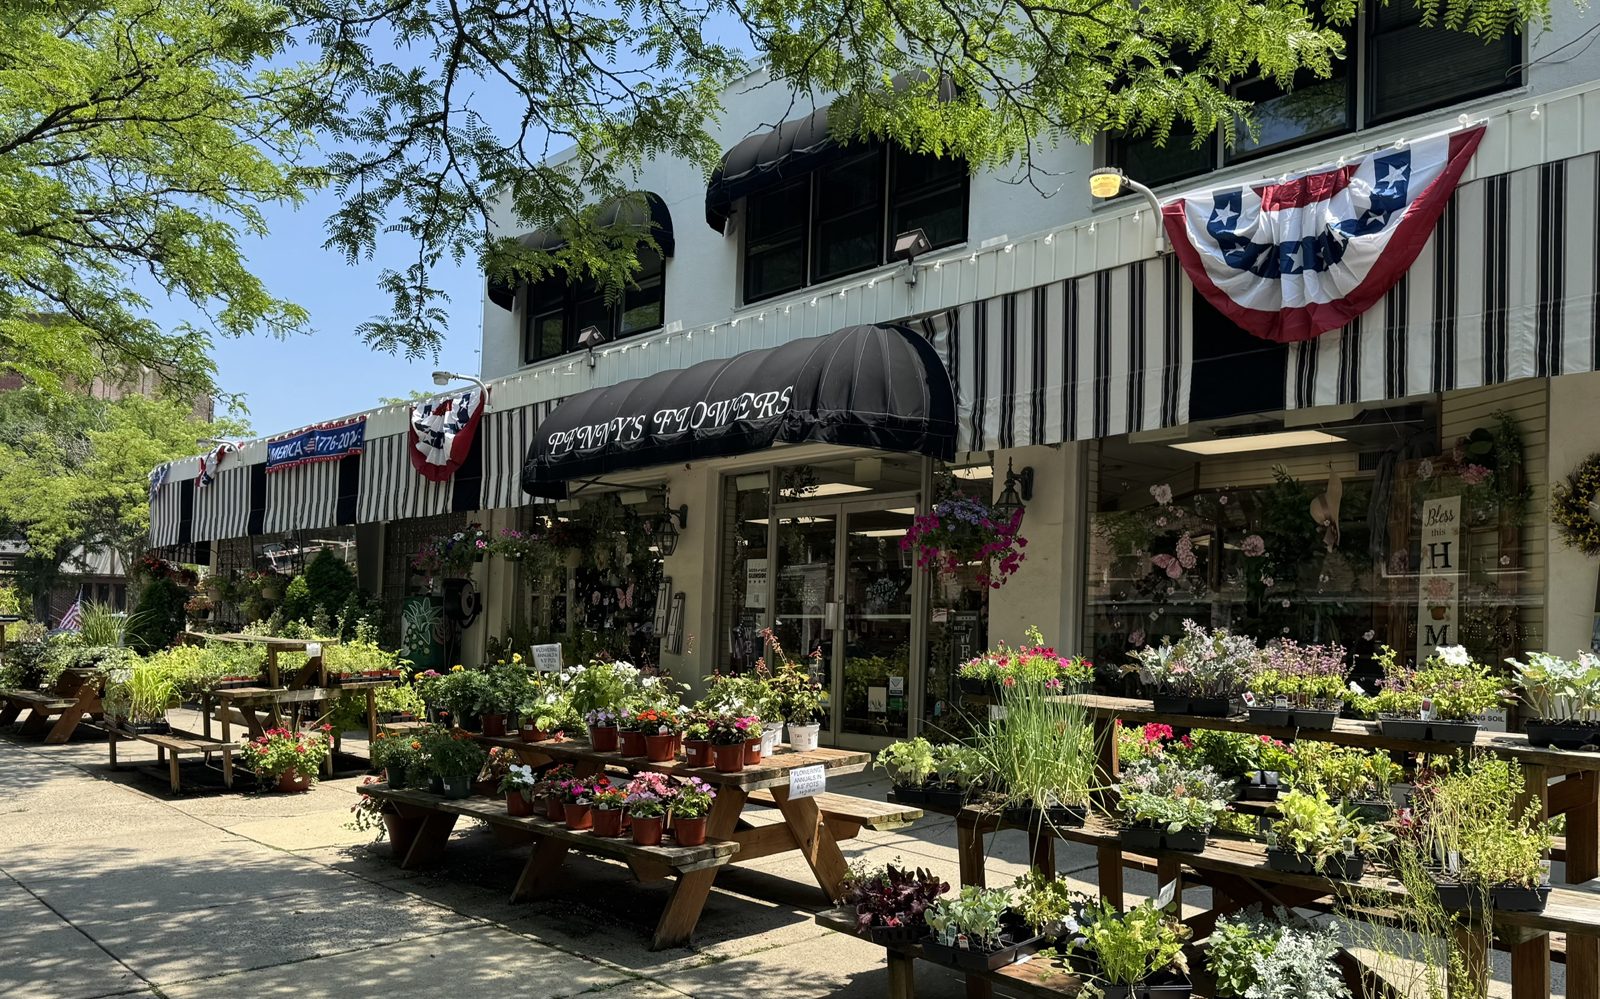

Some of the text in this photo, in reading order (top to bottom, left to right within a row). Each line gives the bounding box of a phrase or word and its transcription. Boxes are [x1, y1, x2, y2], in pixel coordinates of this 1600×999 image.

[548, 385, 794, 454] PENNY'S FLOWERS
[1424, 504, 1456, 527] Bless
[1431, 528, 1446, 537] this
[794, 775, 816, 783] ANNUALS
[806, 781, 819, 789] POTS
